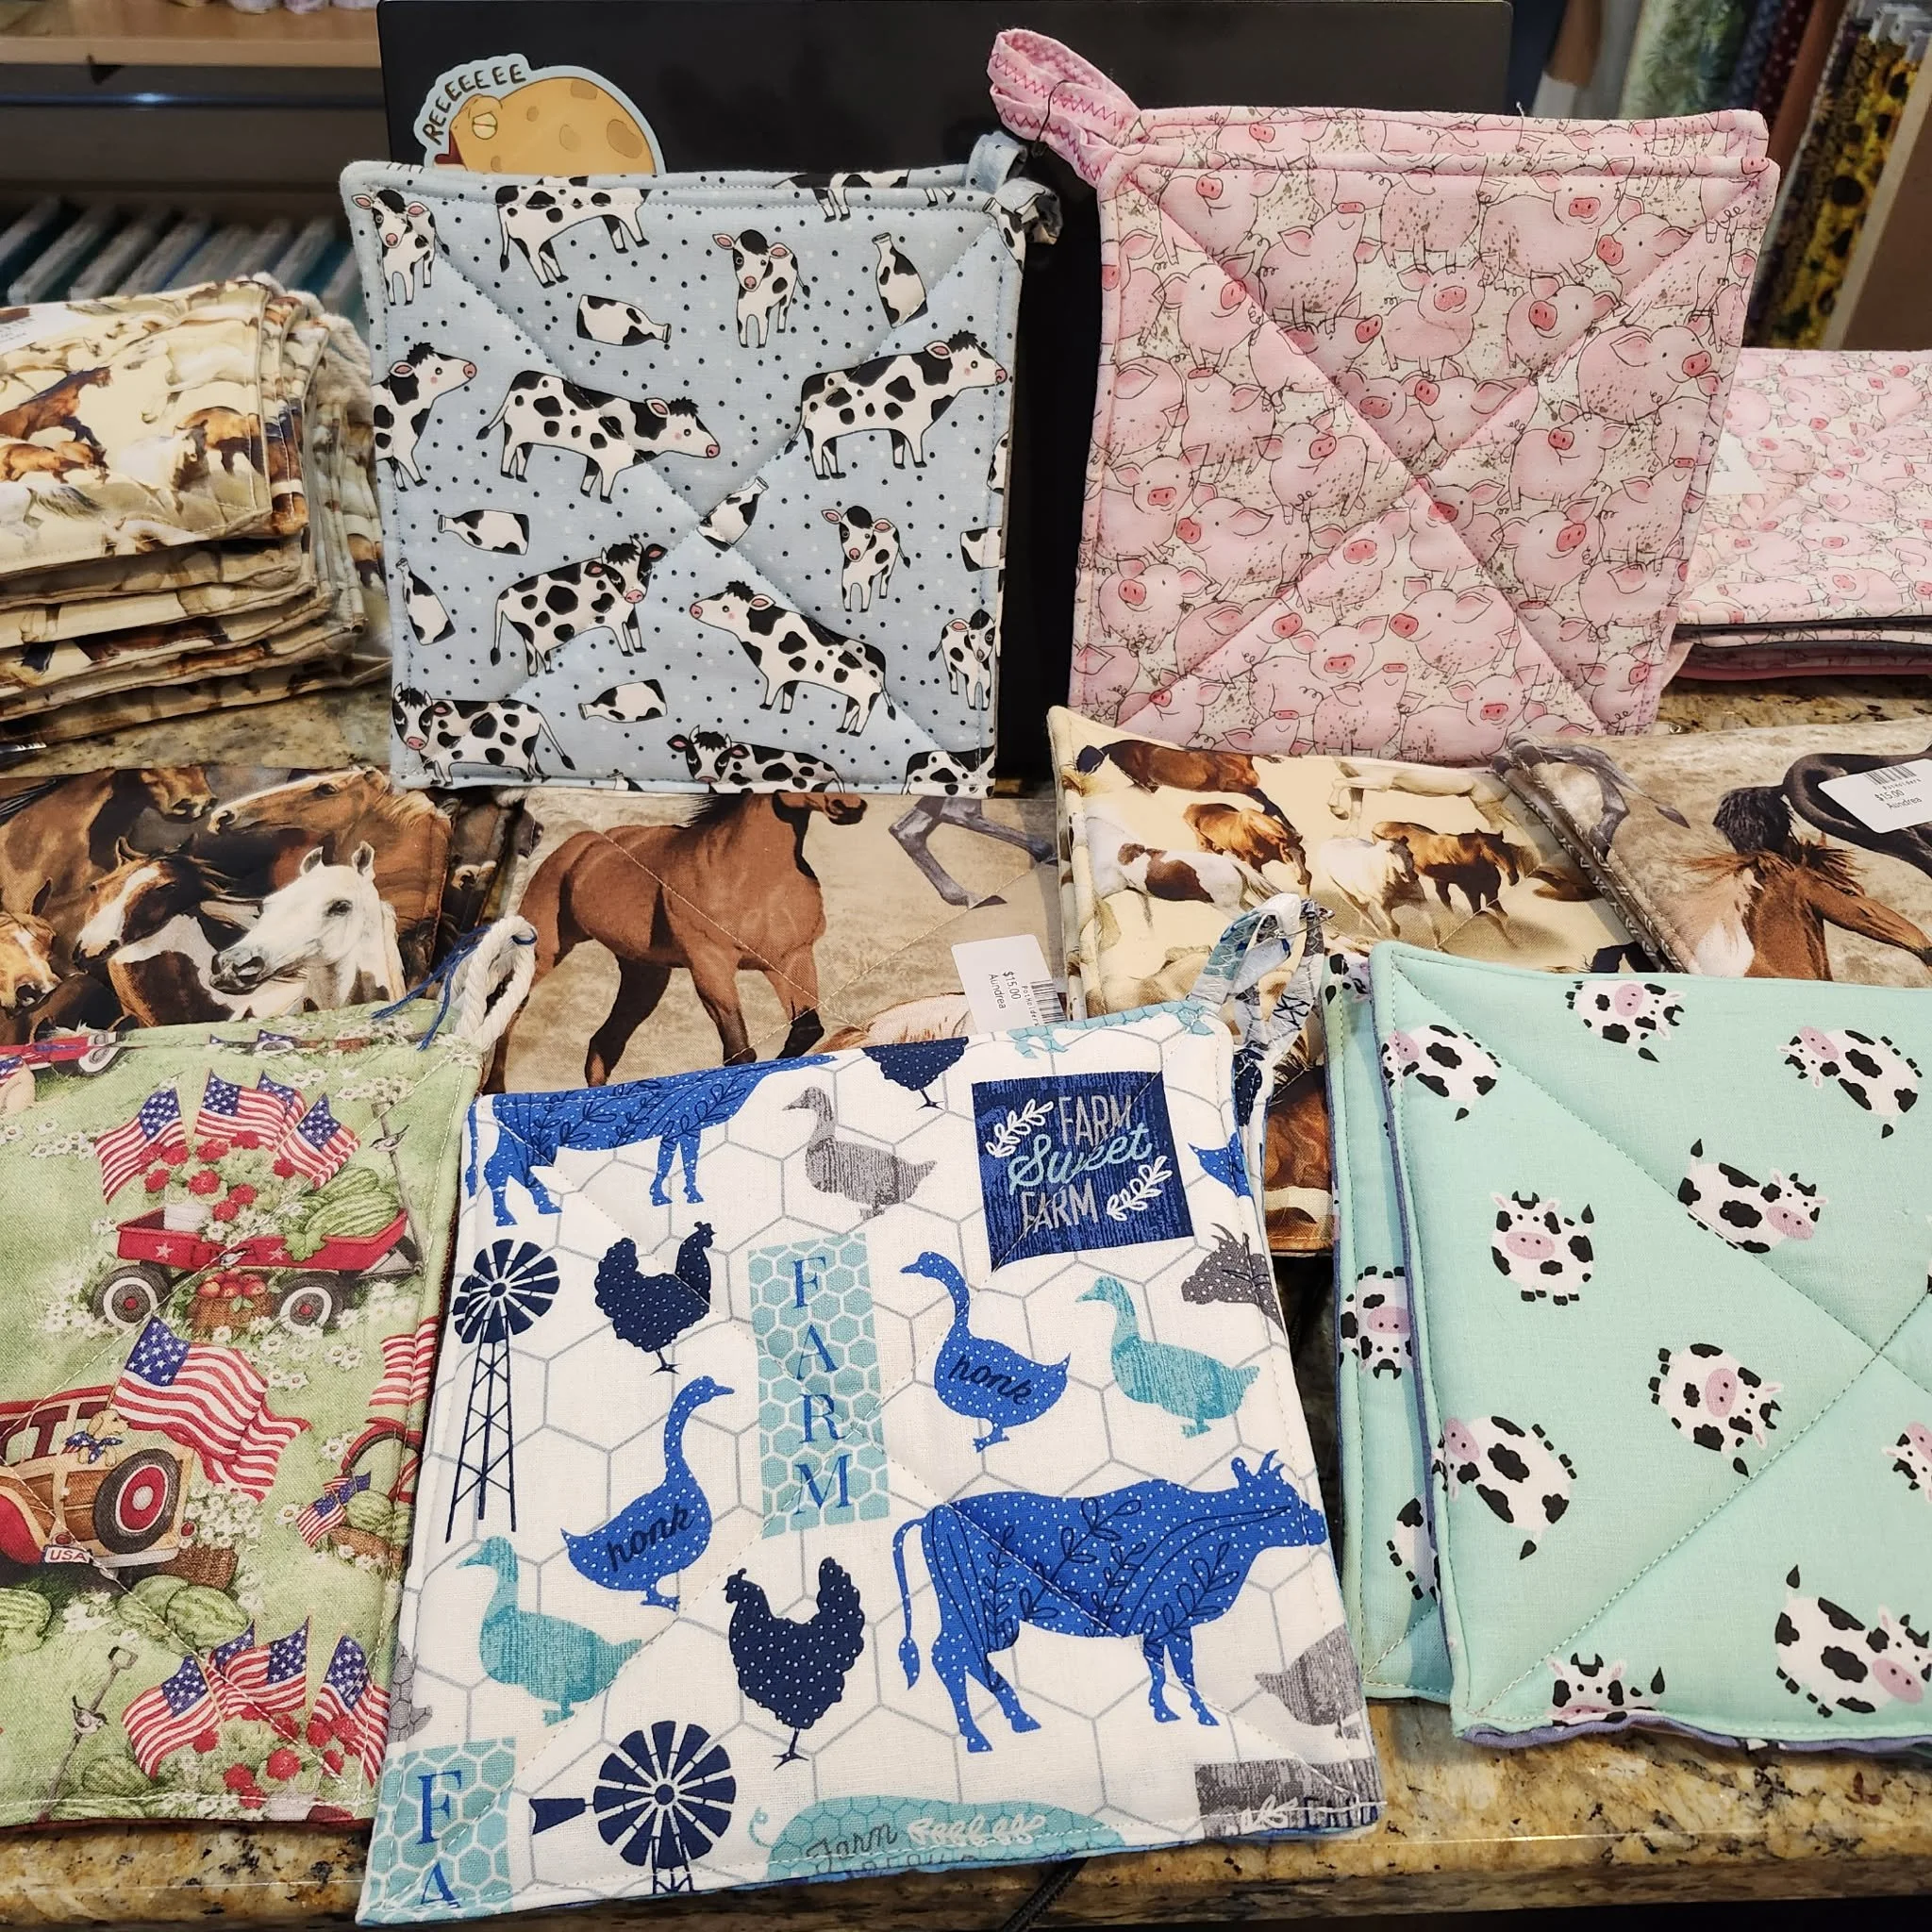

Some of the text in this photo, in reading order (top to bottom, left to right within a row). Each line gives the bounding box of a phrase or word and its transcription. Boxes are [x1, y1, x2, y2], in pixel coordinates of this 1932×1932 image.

[422, 63, 526, 145] REEEEEEE
[1874, 789, 1905, 802] $15.00
[989, 974, 1007, 1009] Aundrea
[1002, 971, 1022, 1000] $15.00
[1058, 1094, 1132, 1146] FARM
[1008, 1122, 1153, 1195] Sweet
[1021, 1178, 1098, 1238] FARM
[947, 1354, 1033, 1406] honk
[49, 1549, 87, 1562] USA
[607, 1503, 696, 1573] honk
